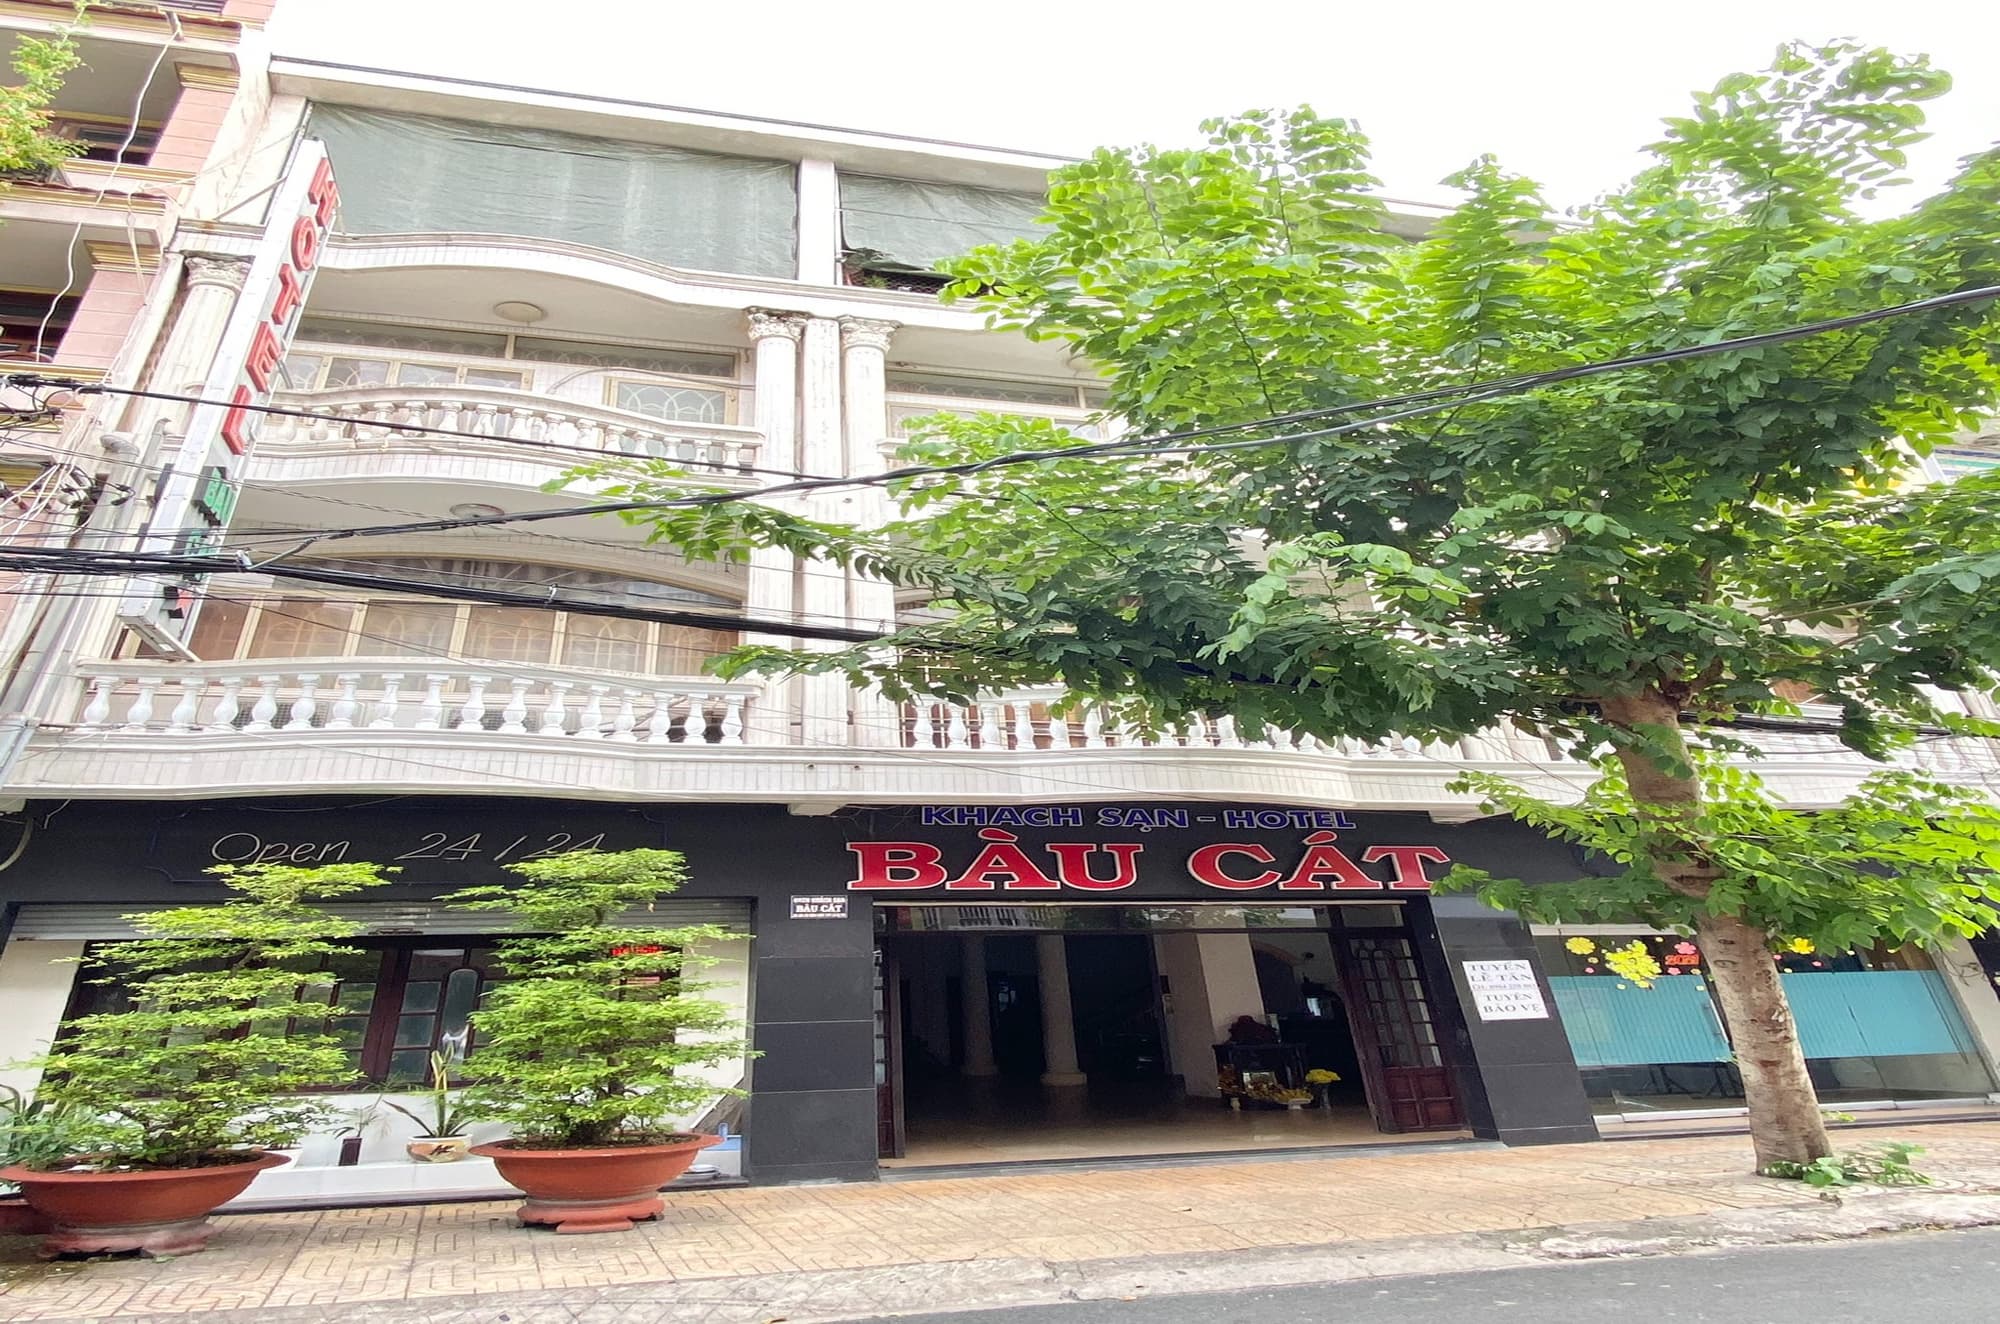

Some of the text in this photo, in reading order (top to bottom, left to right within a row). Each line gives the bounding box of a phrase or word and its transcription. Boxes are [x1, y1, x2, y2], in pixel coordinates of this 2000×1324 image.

[221, 157, 338, 456] HOTEL
[1097, 808, 1189, 833] SẠN
[1224, 809, 1357, 829] HOTEL
[211, 832, 352, 864] Open
[846, 827, 1451, 891] BÀU CÁT
